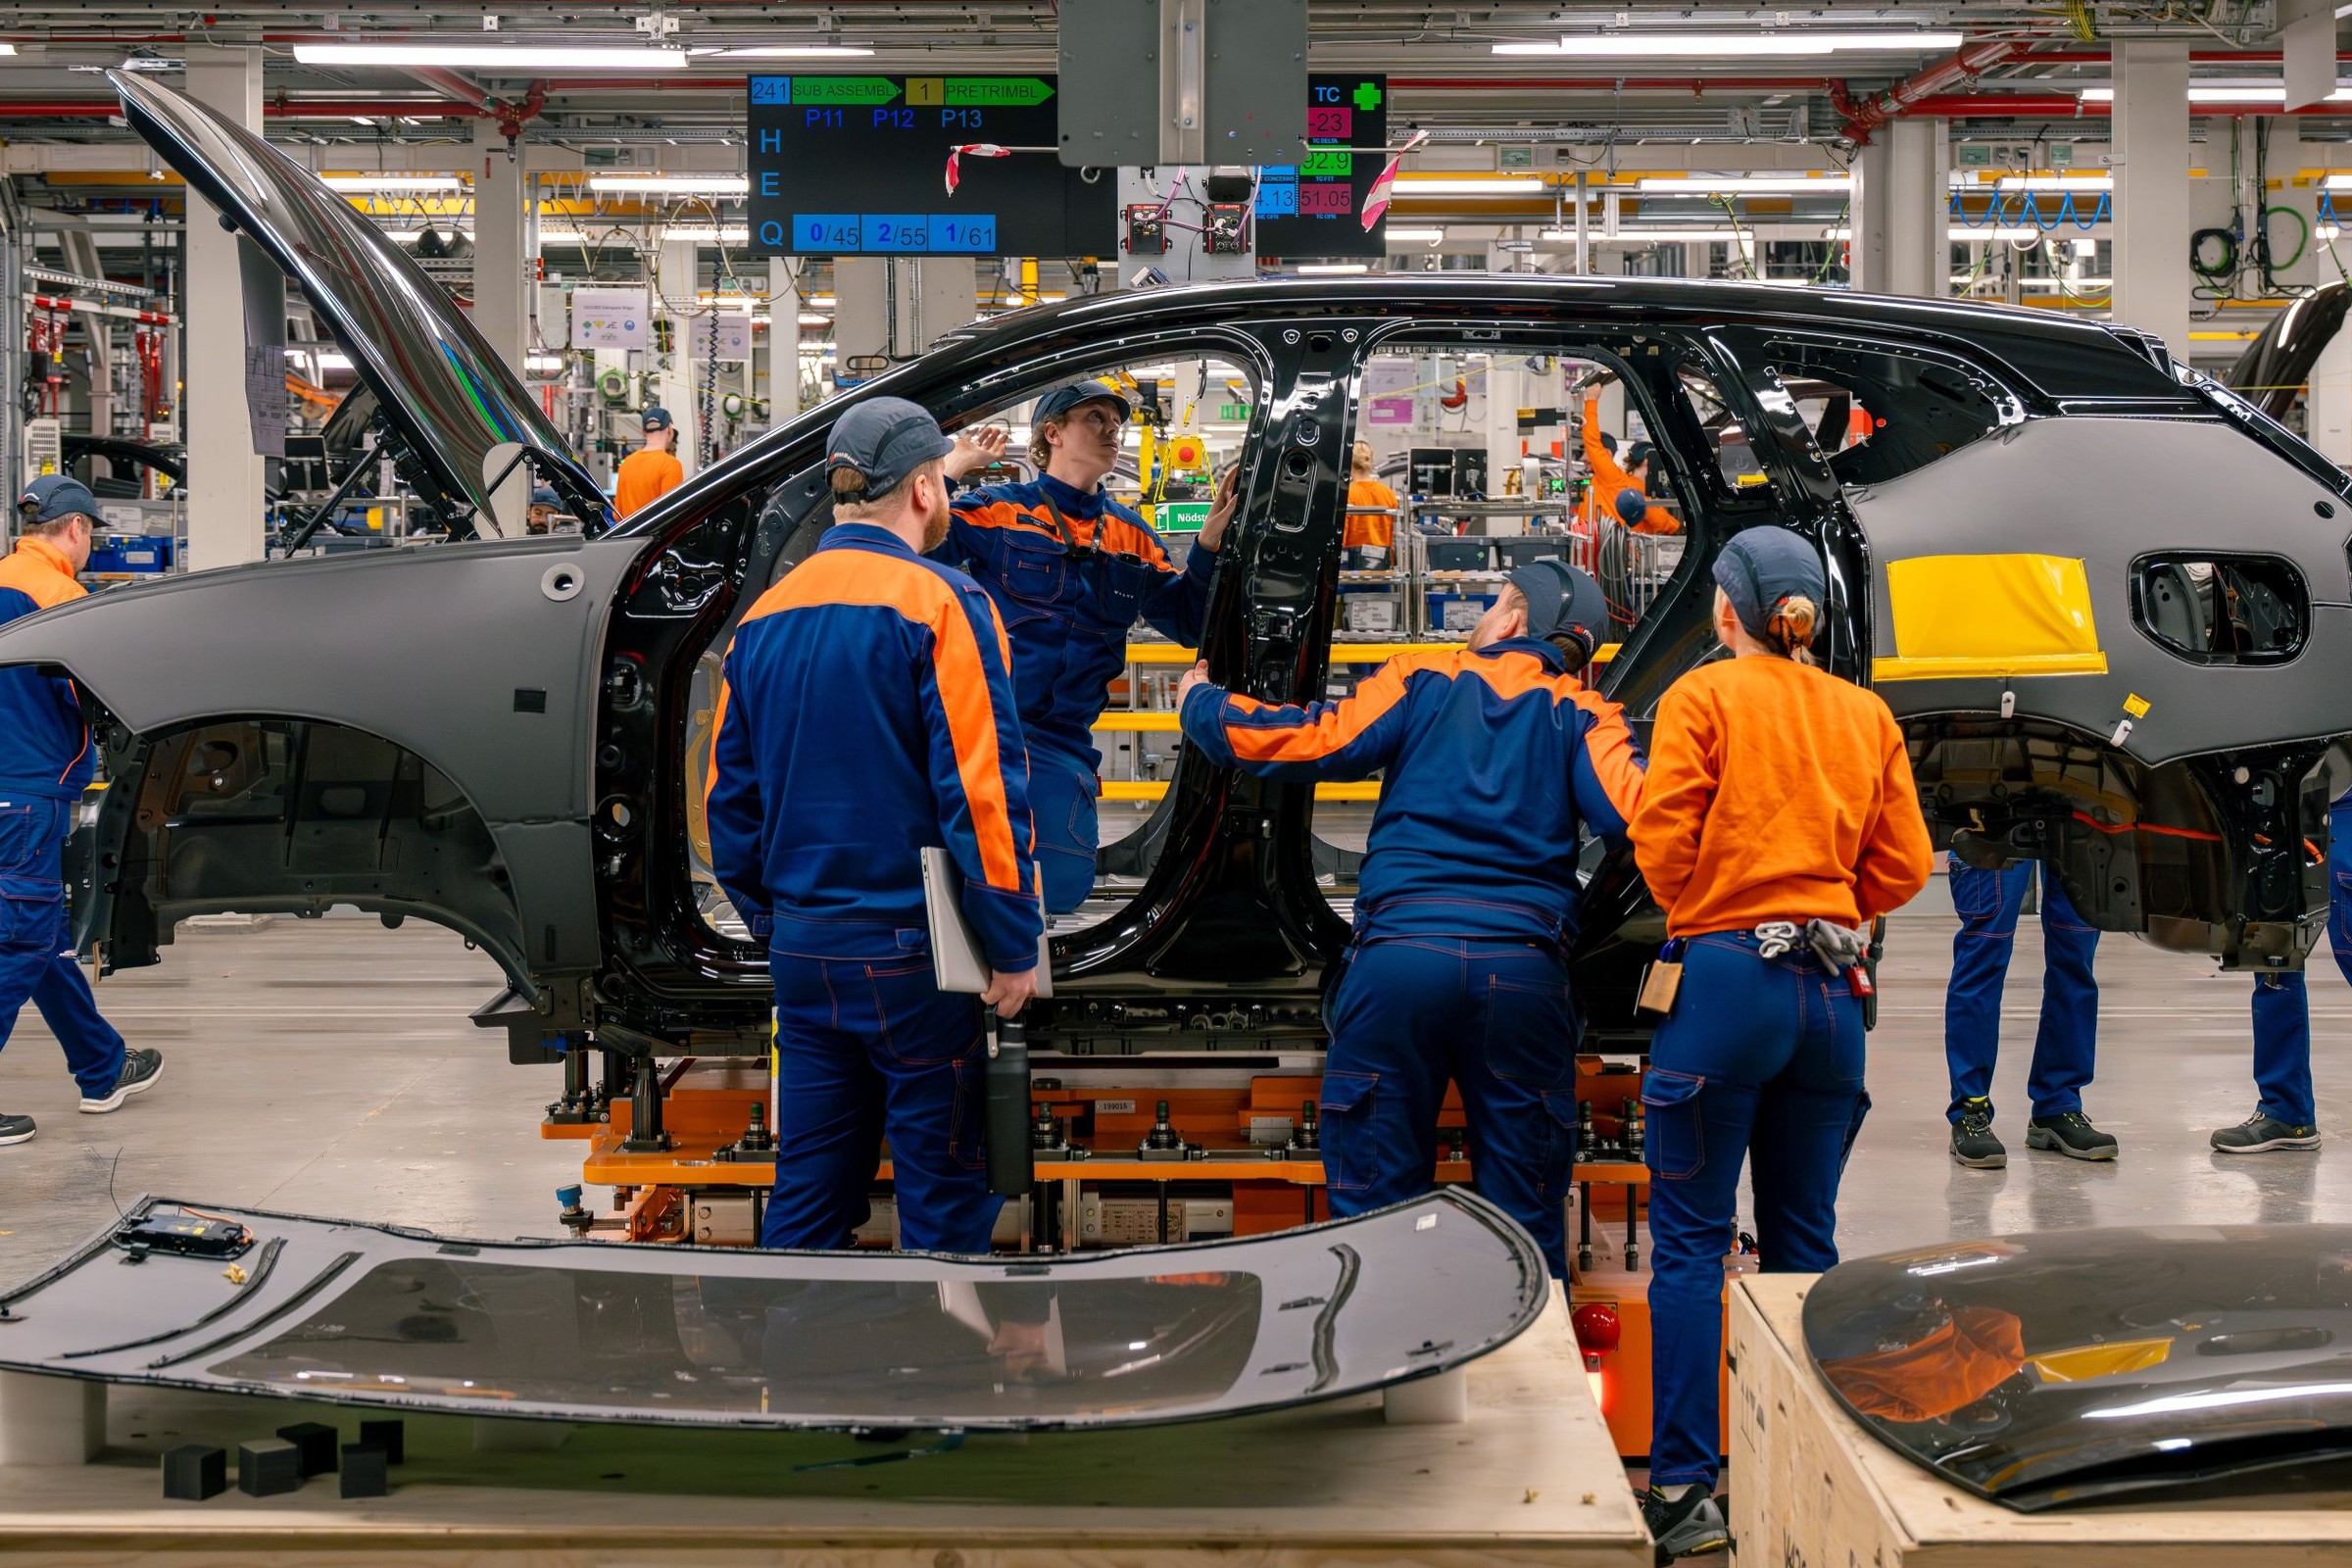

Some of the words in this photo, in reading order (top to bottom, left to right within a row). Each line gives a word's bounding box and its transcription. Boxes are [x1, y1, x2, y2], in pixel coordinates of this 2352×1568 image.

[753, 82, 786, 99] 241
[793, 84, 822, 97] SUB
[920, 83, 928, 101] 1
[947, 84, 1038, 98] PRETRIMBL
[1315, 86, 1341, 102] TC
[806, 109, 843, 127] P11
[873, 109, 914, 127] P12
[942, 109, 983, 127] P13
[760, 128, 781, 153] H
[760, 172, 780, 196] E
[1301, 190, 1350, 207] 51.05
[760, 220, 783, 246] Q
[809, 222, 858, 245] 0/45
[878, 222, 926, 245] 2/55
[946, 222, 993, 246] 1/61
[1177, 513, 1208, 522] Nödst
